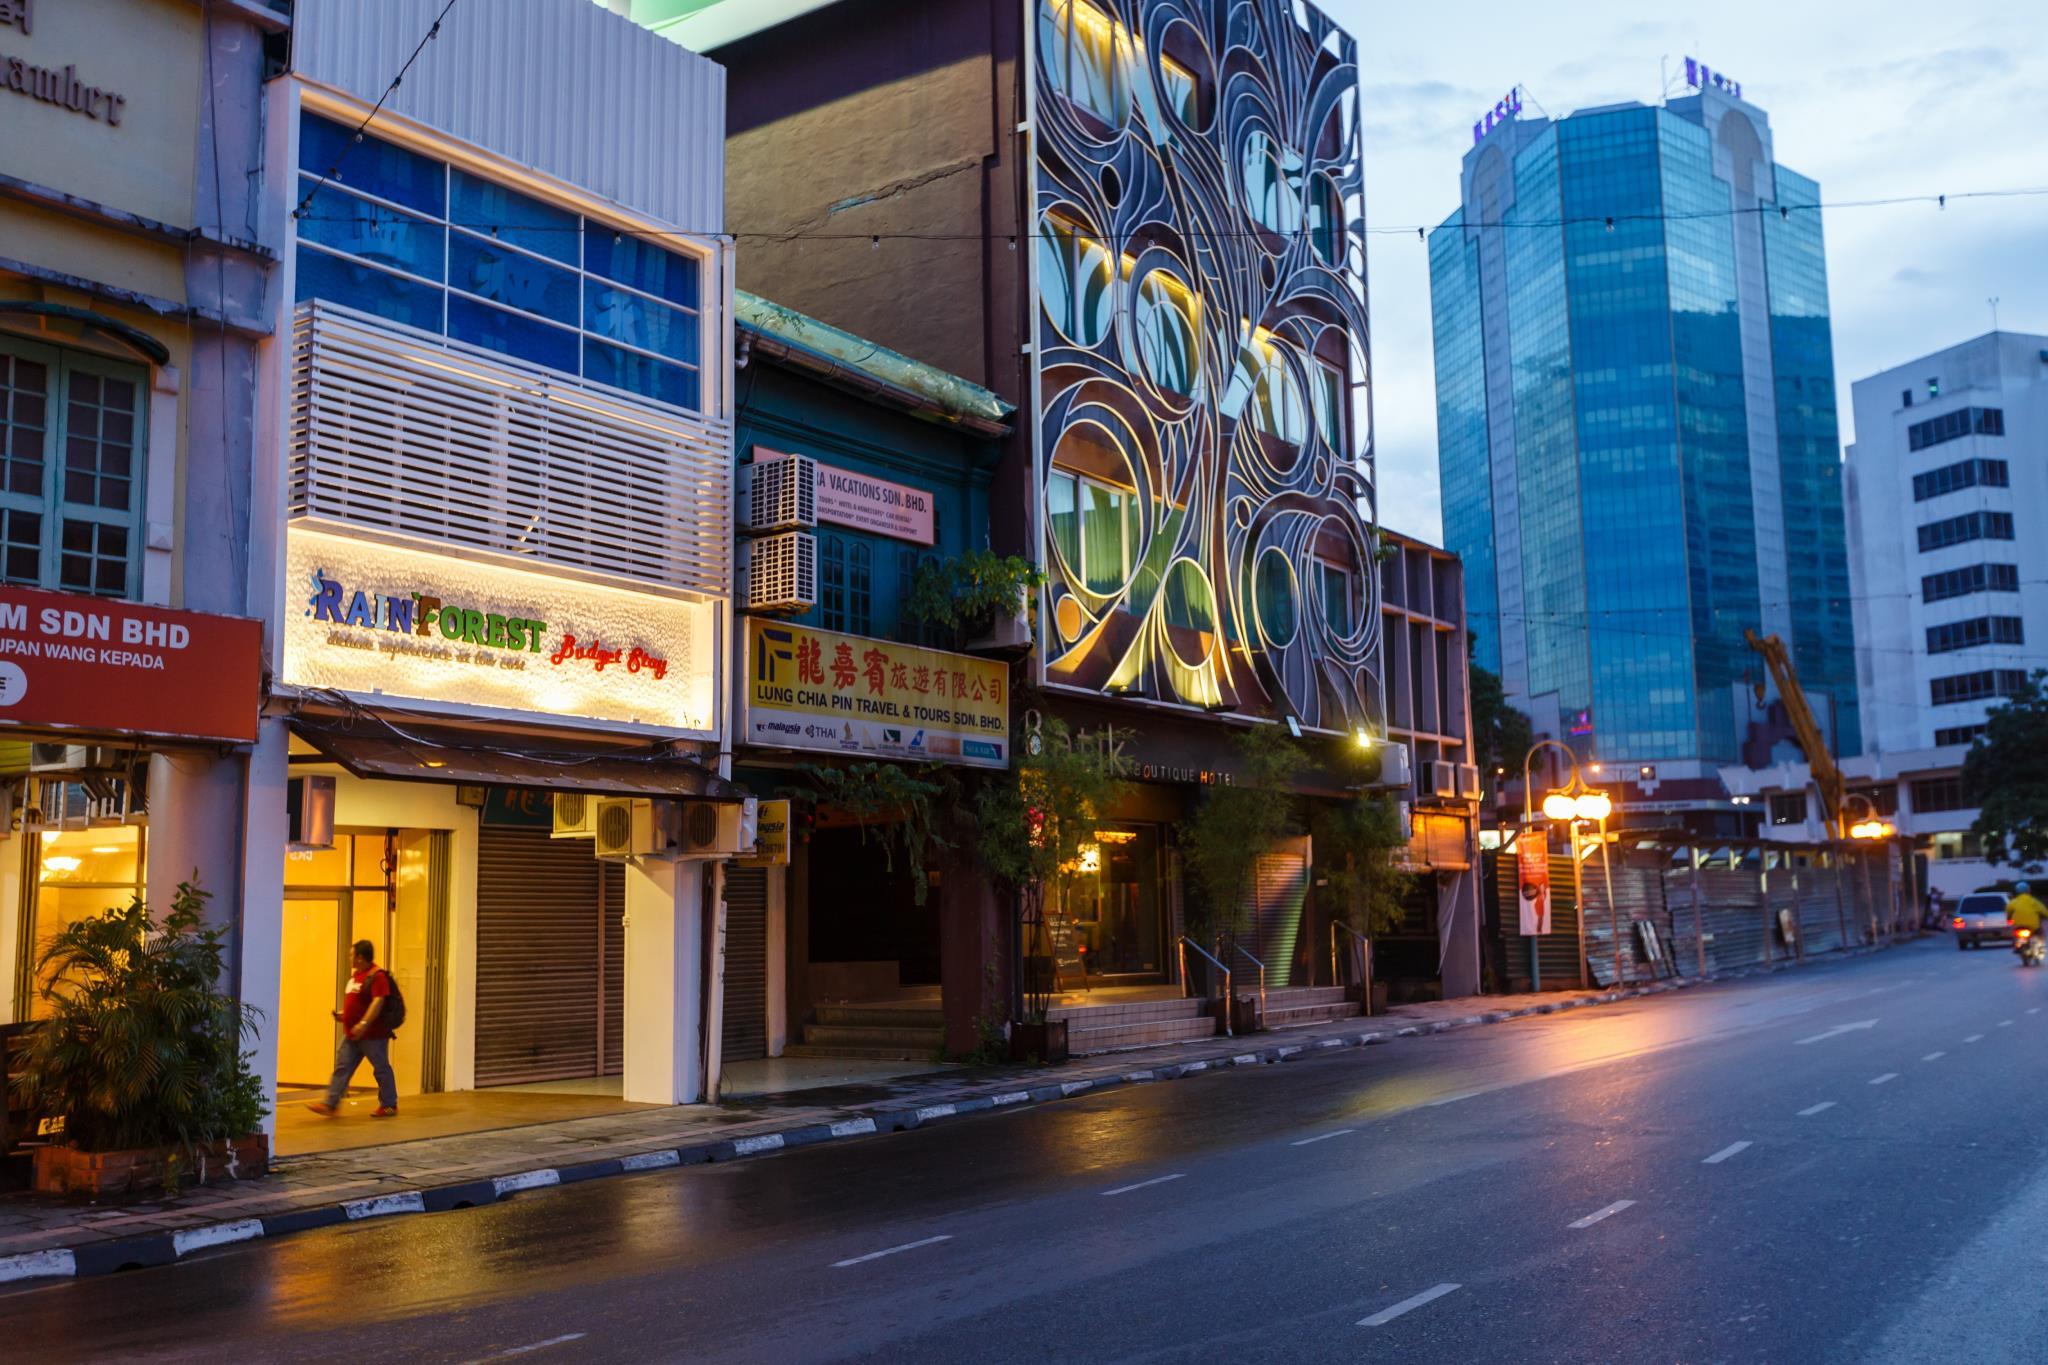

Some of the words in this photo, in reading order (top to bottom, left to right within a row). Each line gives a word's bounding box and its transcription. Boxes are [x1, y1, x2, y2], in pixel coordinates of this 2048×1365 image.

[816, 472, 826, 488] A
[829, 473, 881, 502] VACATIONS
[882, 487, 905, 508] SDN.
[905, 495, 927, 513] BHD.
[40, 607, 110, 641] SDN
[122, 617, 190, 650] BHD
[314, 579, 548, 653] RAINFOREST
[44, 643, 96, 664] WANG
[100, 649, 165, 671] KEPADA
[550, 634, 623, 673] Budget
[627, 646, 668, 681] Stay
[796, 635, 1002, 705] 龍嘉賓旅遊有限公司
[757, 684, 794, 703] LUNG
[797, 689, 828, 709] CHIA
[831, 694, 853, 712] PIN
[856, 698, 900, 718] TRAVEL
[902, 704, 911, 718] &
[914, 705, 951, 724] TOURS
[953, 711, 978, 728] SDN.
[980, 716, 1004, 731] BHD.
[767, 721, 801, 735] malaysia
[815, 726, 837, 739] THAI
[1134, 762, 1195, 783] BOUTIQUE
[1199, 768, 1237, 788] HOTEL
